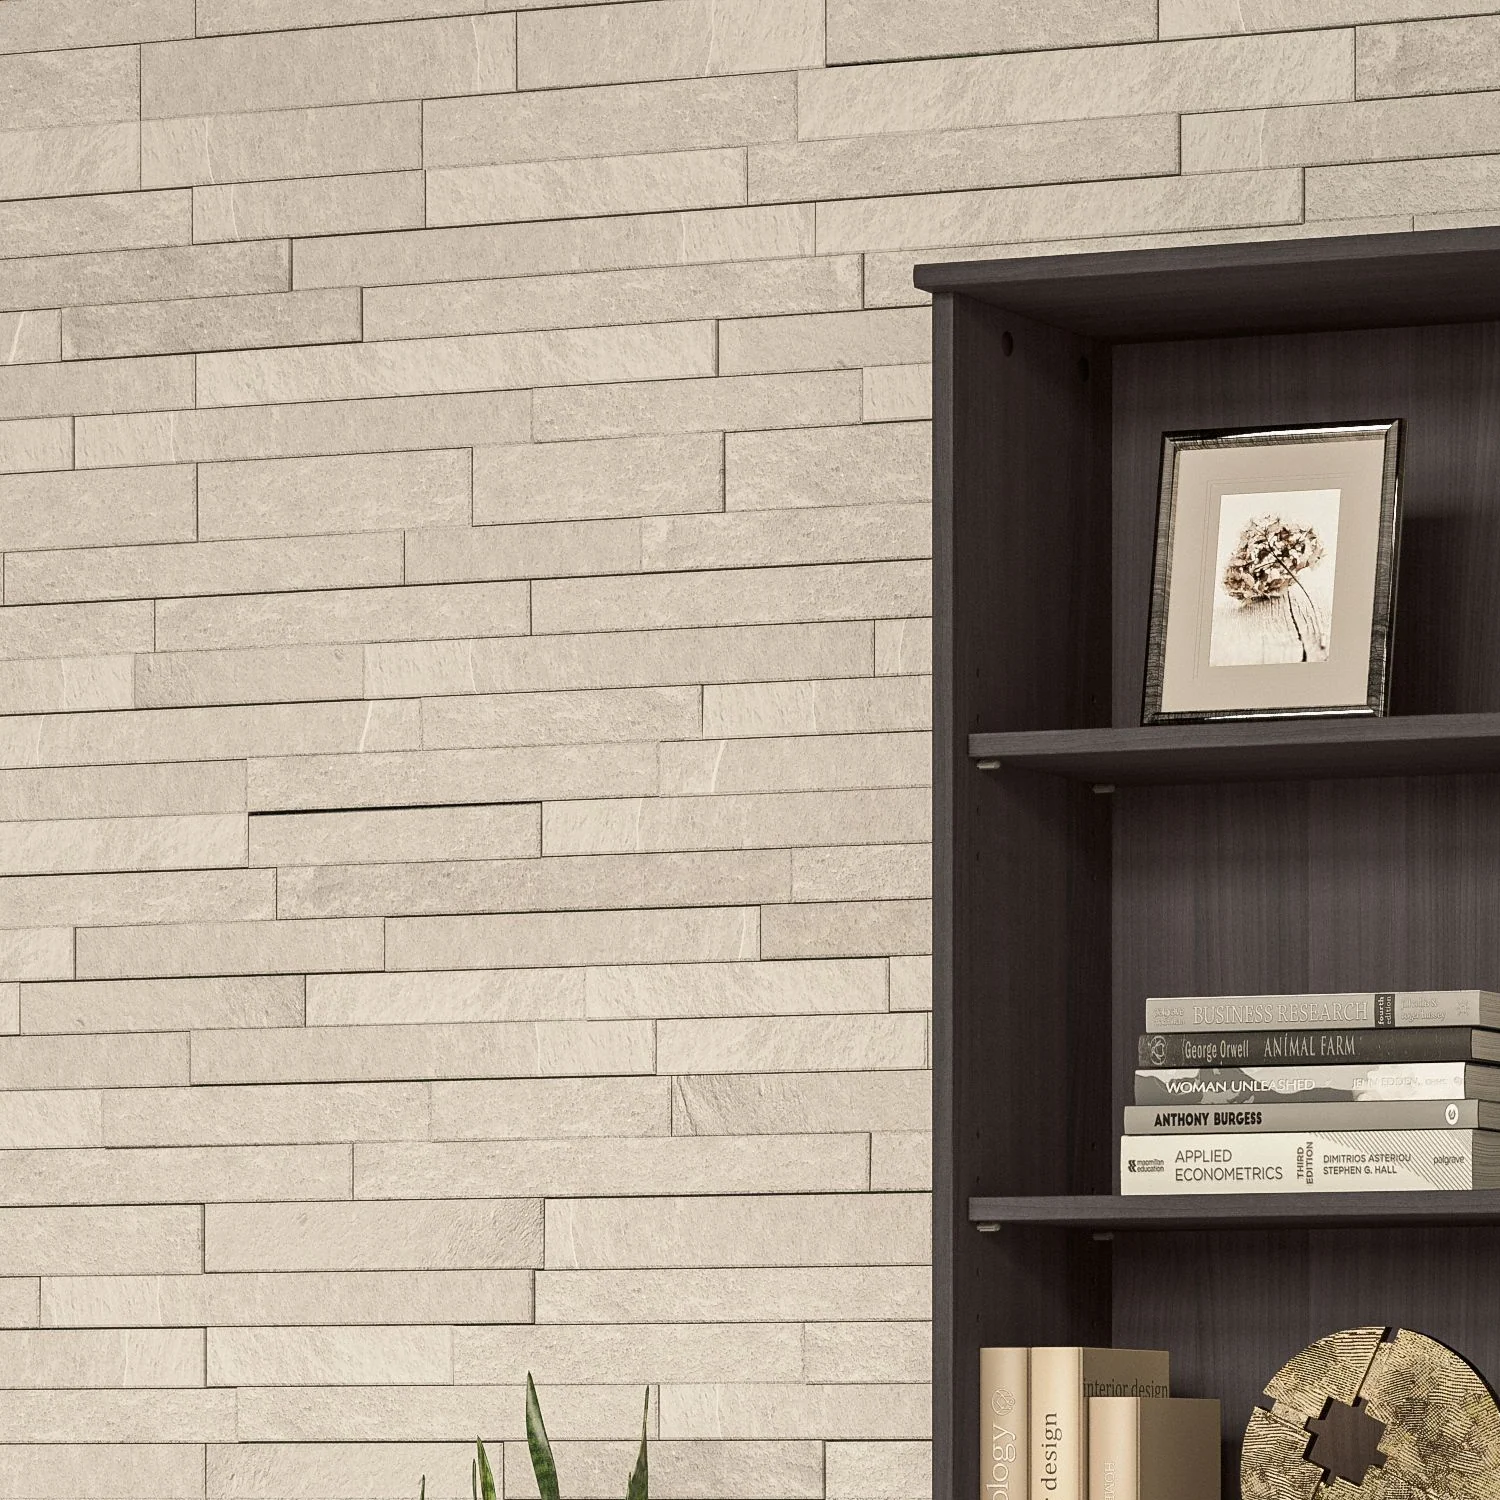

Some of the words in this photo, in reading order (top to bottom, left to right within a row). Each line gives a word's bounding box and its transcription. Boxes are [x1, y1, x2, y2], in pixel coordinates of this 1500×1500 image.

[1193, 1004, 1273, 1025] BUSINESS
[1276, 1001, 1368, 1023] RESEARCH
[1377, 995, 1385, 1025] fourth
[1184, 1040, 1217, 1062] George
[1220, 1039, 1249, 1059] Orwell
[1320, 1035, 1356, 1057] FARM
[1165, 1081, 1227, 1094] WOMAN
[1231, 1079, 1316, 1093] UNLEASHED
[1154, 1112, 1210, 1127] ANTHONY
[1213, 1111, 1263, 1126] BURGESS
[1174, 1149, 1233, 1163] APPLIED
[1296, 1146, 1304, 1180] THIRD
[1306, 1141, 1314, 1185] EDITION
[1323, 1154, 1367, 1164] DIMITRIOS
[1368, 1153, 1411, 1163] ASTERIOU
[1433, 1155, 1465, 1166] palgrave
[1136, 1165, 1165, 1173] education
[1175, 1166, 1283, 1181] ECONOMETRICS
[1323, 1166, 1362, 1175] STEPHEN
[1364, 1165, 1373, 1175] G.
[1375, 1165, 1398, 1175] HALL
[1083, 1378, 1128, 1397] interior
[1131, 1378, 1168, 1398] design
[1040, 1412, 1063, 1491] design
